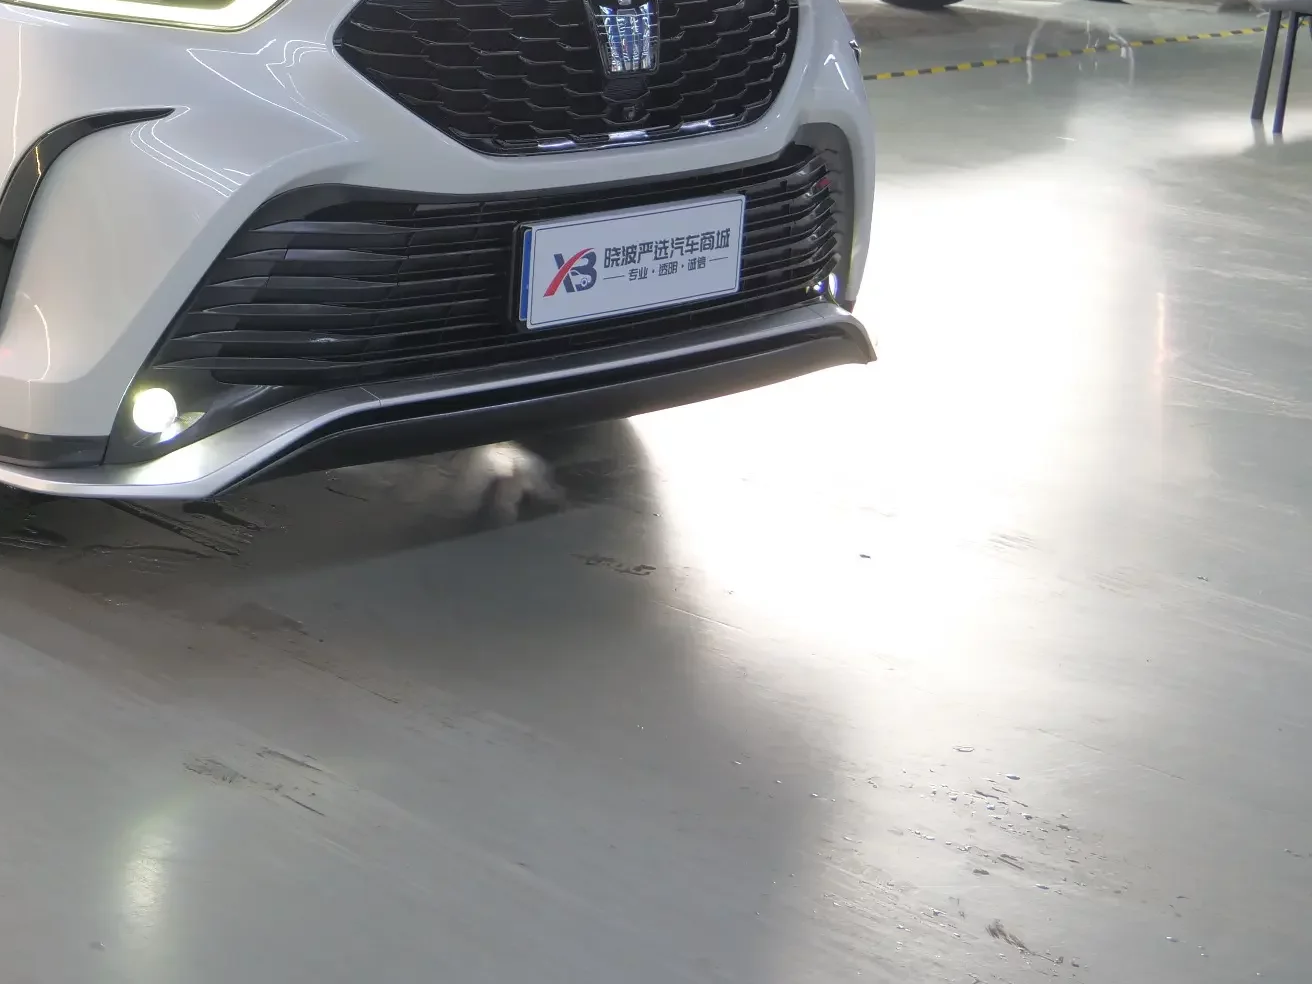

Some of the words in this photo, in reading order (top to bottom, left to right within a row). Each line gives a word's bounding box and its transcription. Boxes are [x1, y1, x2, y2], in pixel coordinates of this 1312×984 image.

[603, 228, 731, 268] 晓波严选汽车商城
